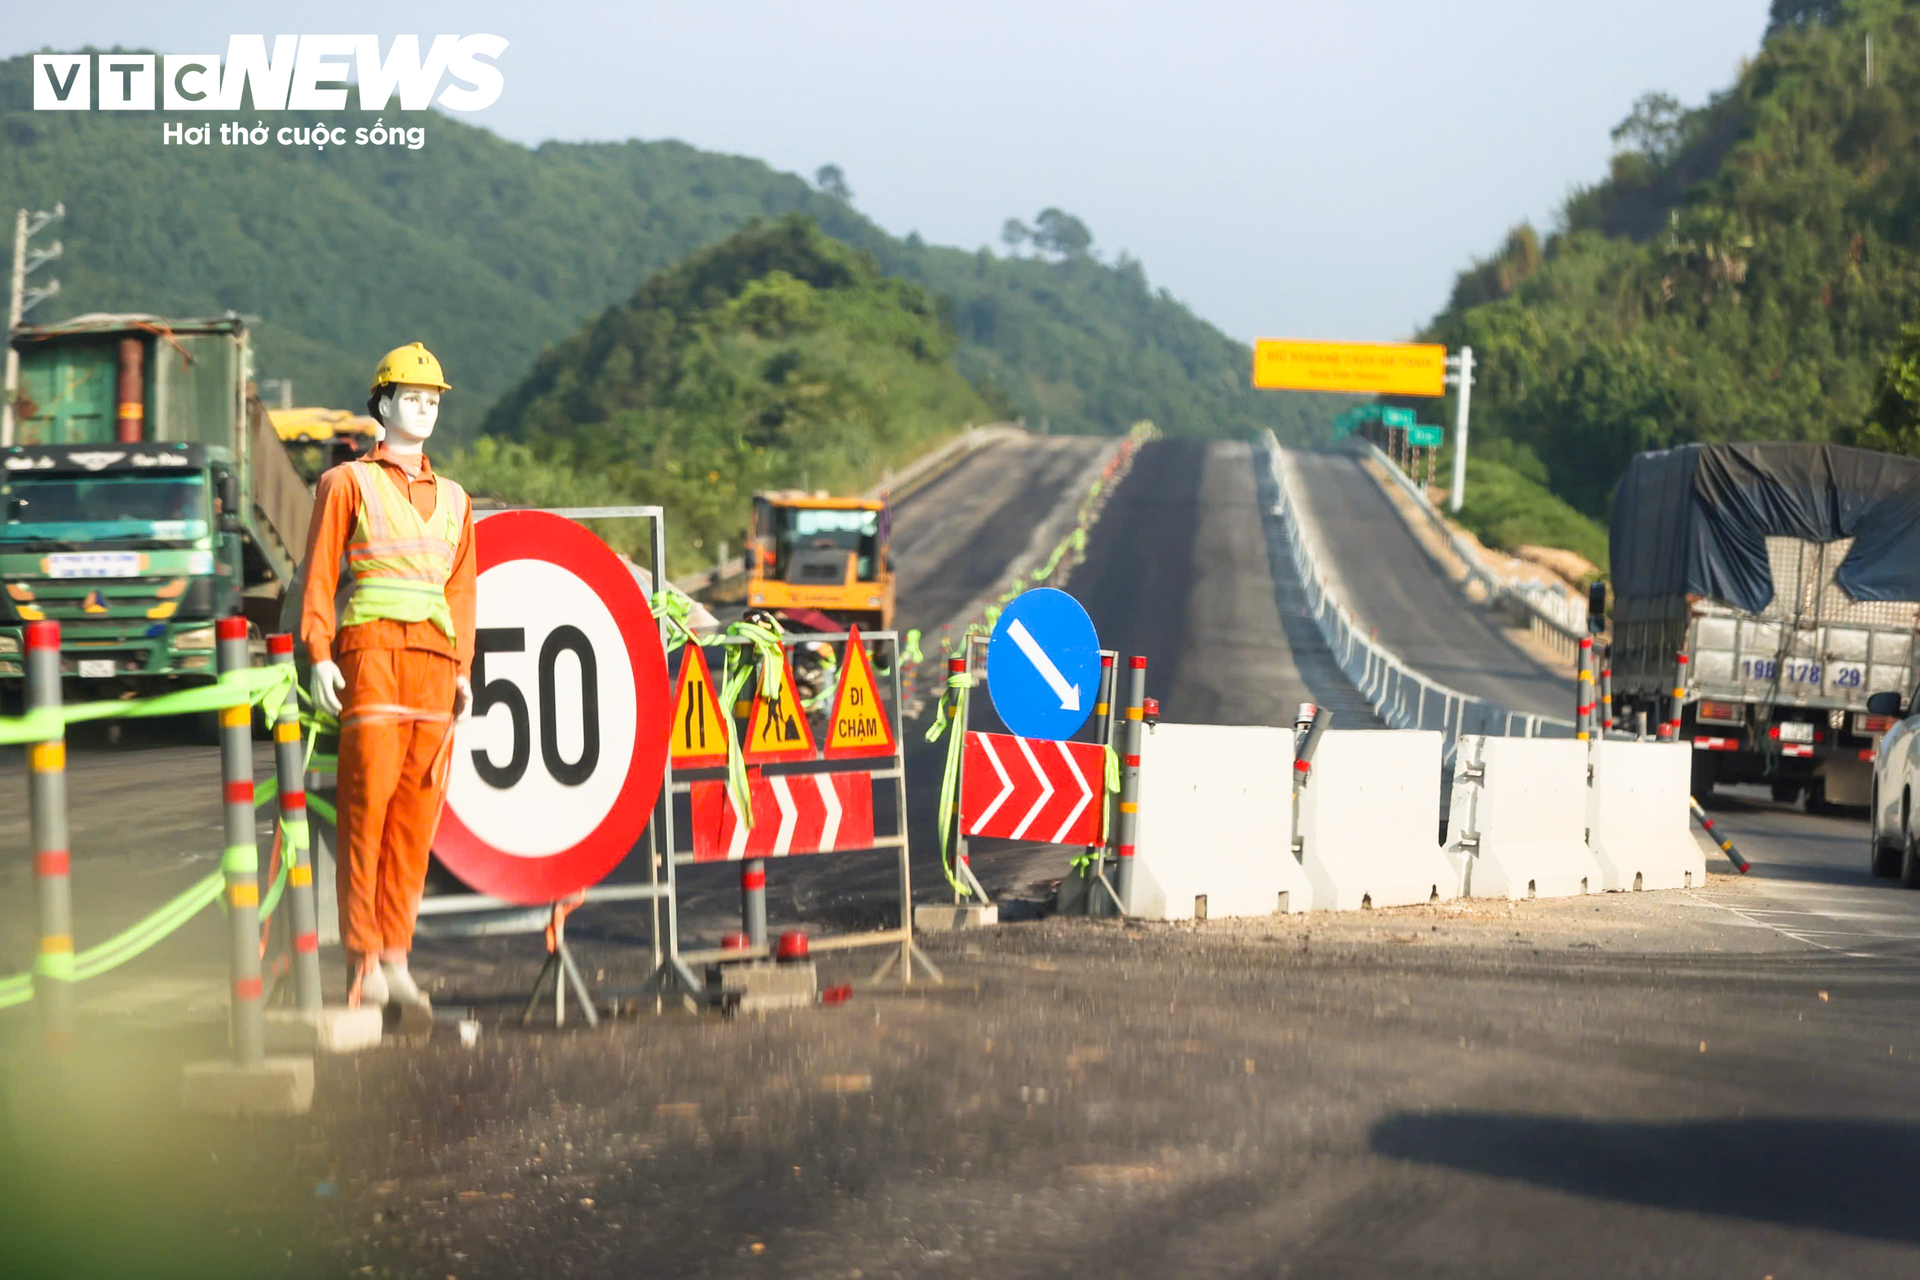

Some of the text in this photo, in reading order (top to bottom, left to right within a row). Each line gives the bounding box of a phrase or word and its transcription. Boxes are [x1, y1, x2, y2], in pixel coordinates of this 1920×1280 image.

[471, 625, 600, 790] 50
[850, 686, 864, 706] ĐI
[838, 712, 878, 743] CHẬM
